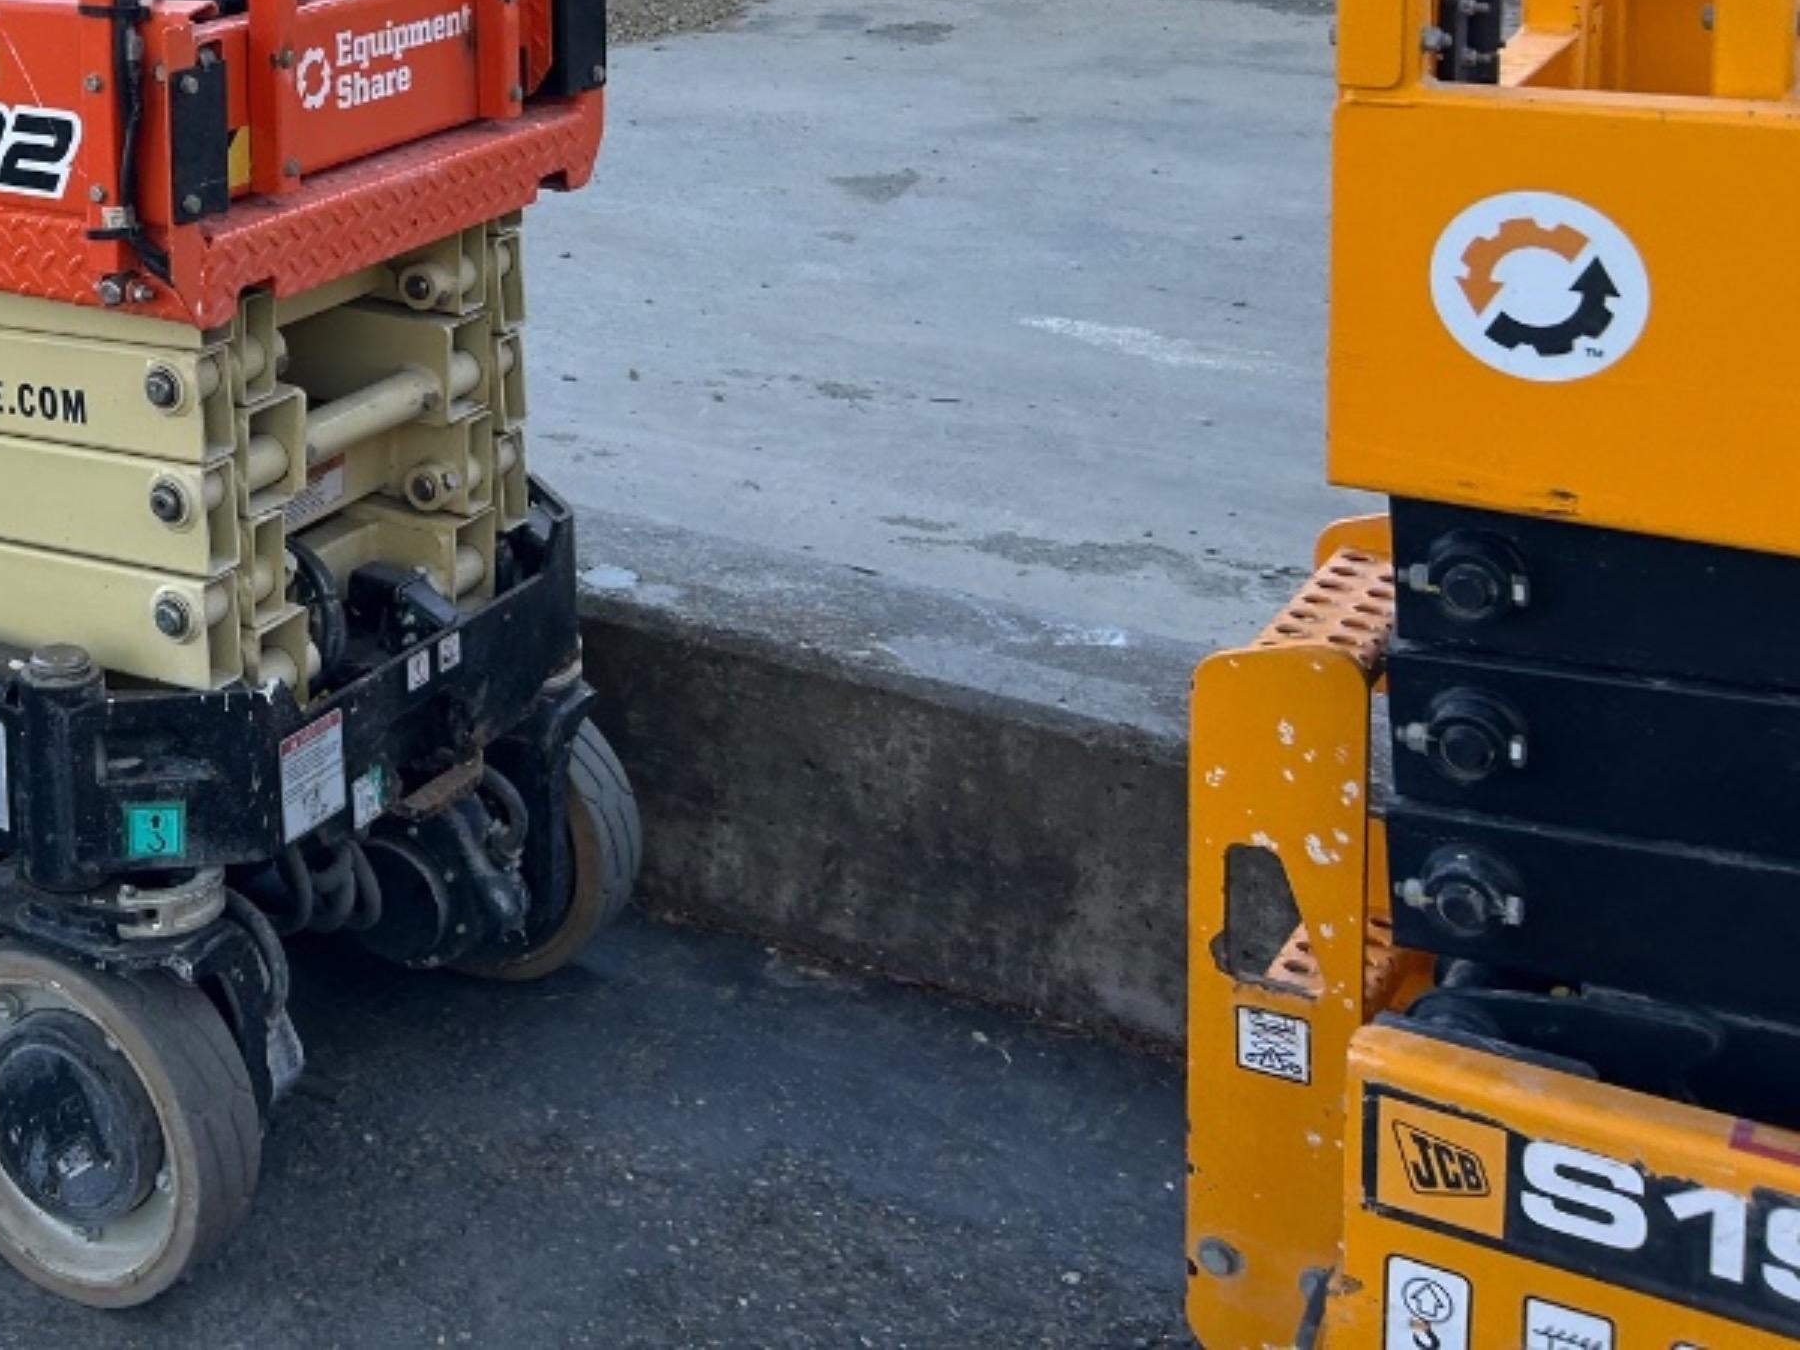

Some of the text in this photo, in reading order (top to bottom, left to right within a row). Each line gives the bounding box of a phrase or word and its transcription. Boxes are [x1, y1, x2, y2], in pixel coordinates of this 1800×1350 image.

[336, 4, 471, 68] Equipment
[337, 65, 412, 109] Share
[1409, 1132, 1484, 1192] JCB
